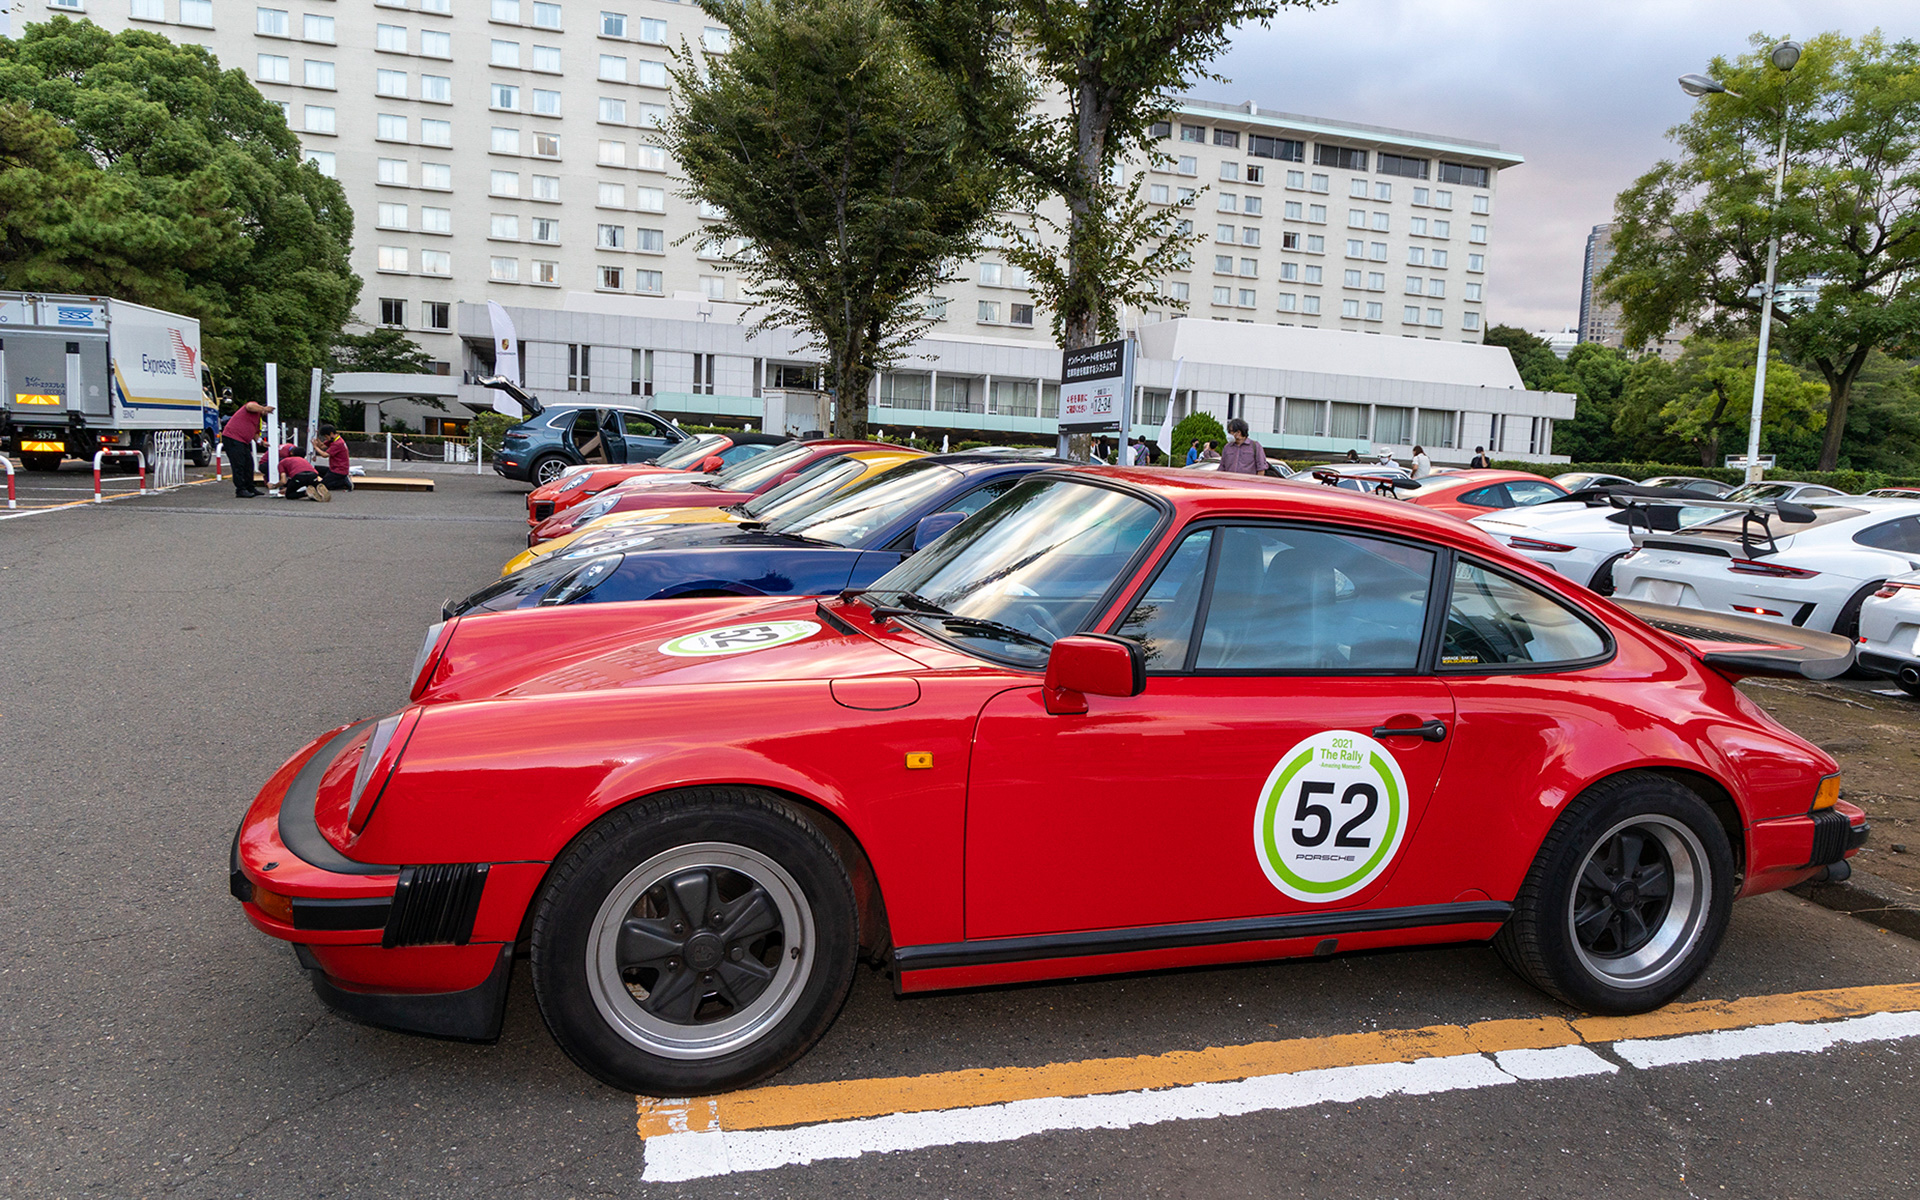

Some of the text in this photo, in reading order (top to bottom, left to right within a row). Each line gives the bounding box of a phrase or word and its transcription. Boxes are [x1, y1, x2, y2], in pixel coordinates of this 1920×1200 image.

[710, 626, 779, 648] 52
[1332, 738, 1353, 748] 2021
[1320, 748, 1364, 764] The Rally
[1292, 781, 1379, 848] 52
[1296, 853, 1356, 862] PORSCHE
